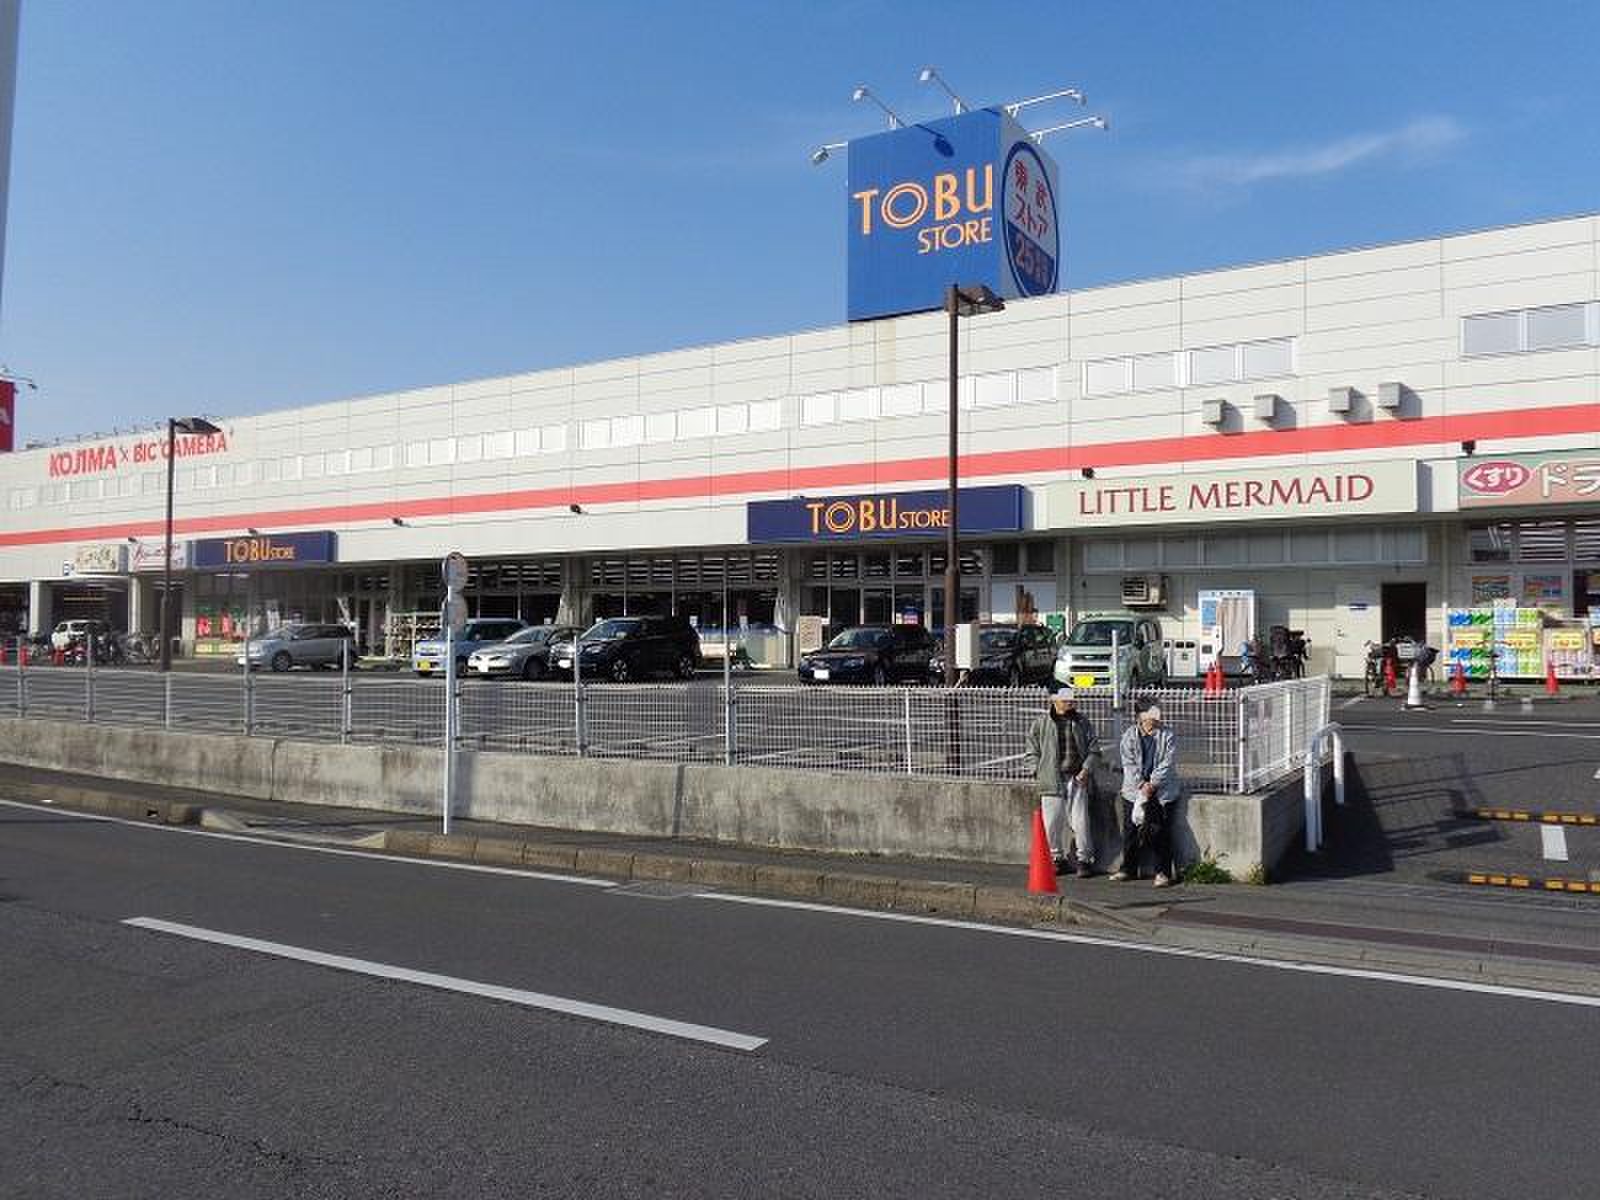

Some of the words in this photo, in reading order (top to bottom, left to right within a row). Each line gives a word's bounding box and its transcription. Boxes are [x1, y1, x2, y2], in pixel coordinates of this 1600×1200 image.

[853, 164, 993, 235] TOBU
[917, 217, 993, 254] STORE
[50, 446, 117, 478] KOJIMA
[133, 440, 157, 463] BIC
[161, 432, 227, 461] CAMERA
[1079, 486, 1176, 515] LITTLE
[1188, 475, 1374, 510] MERMAID
[1466, 466, 1525, 488] くすり
[806, 498, 897, 534] TOBU
[899, 510, 952, 529] STORE
[223, 538, 271, 563] TOBU
